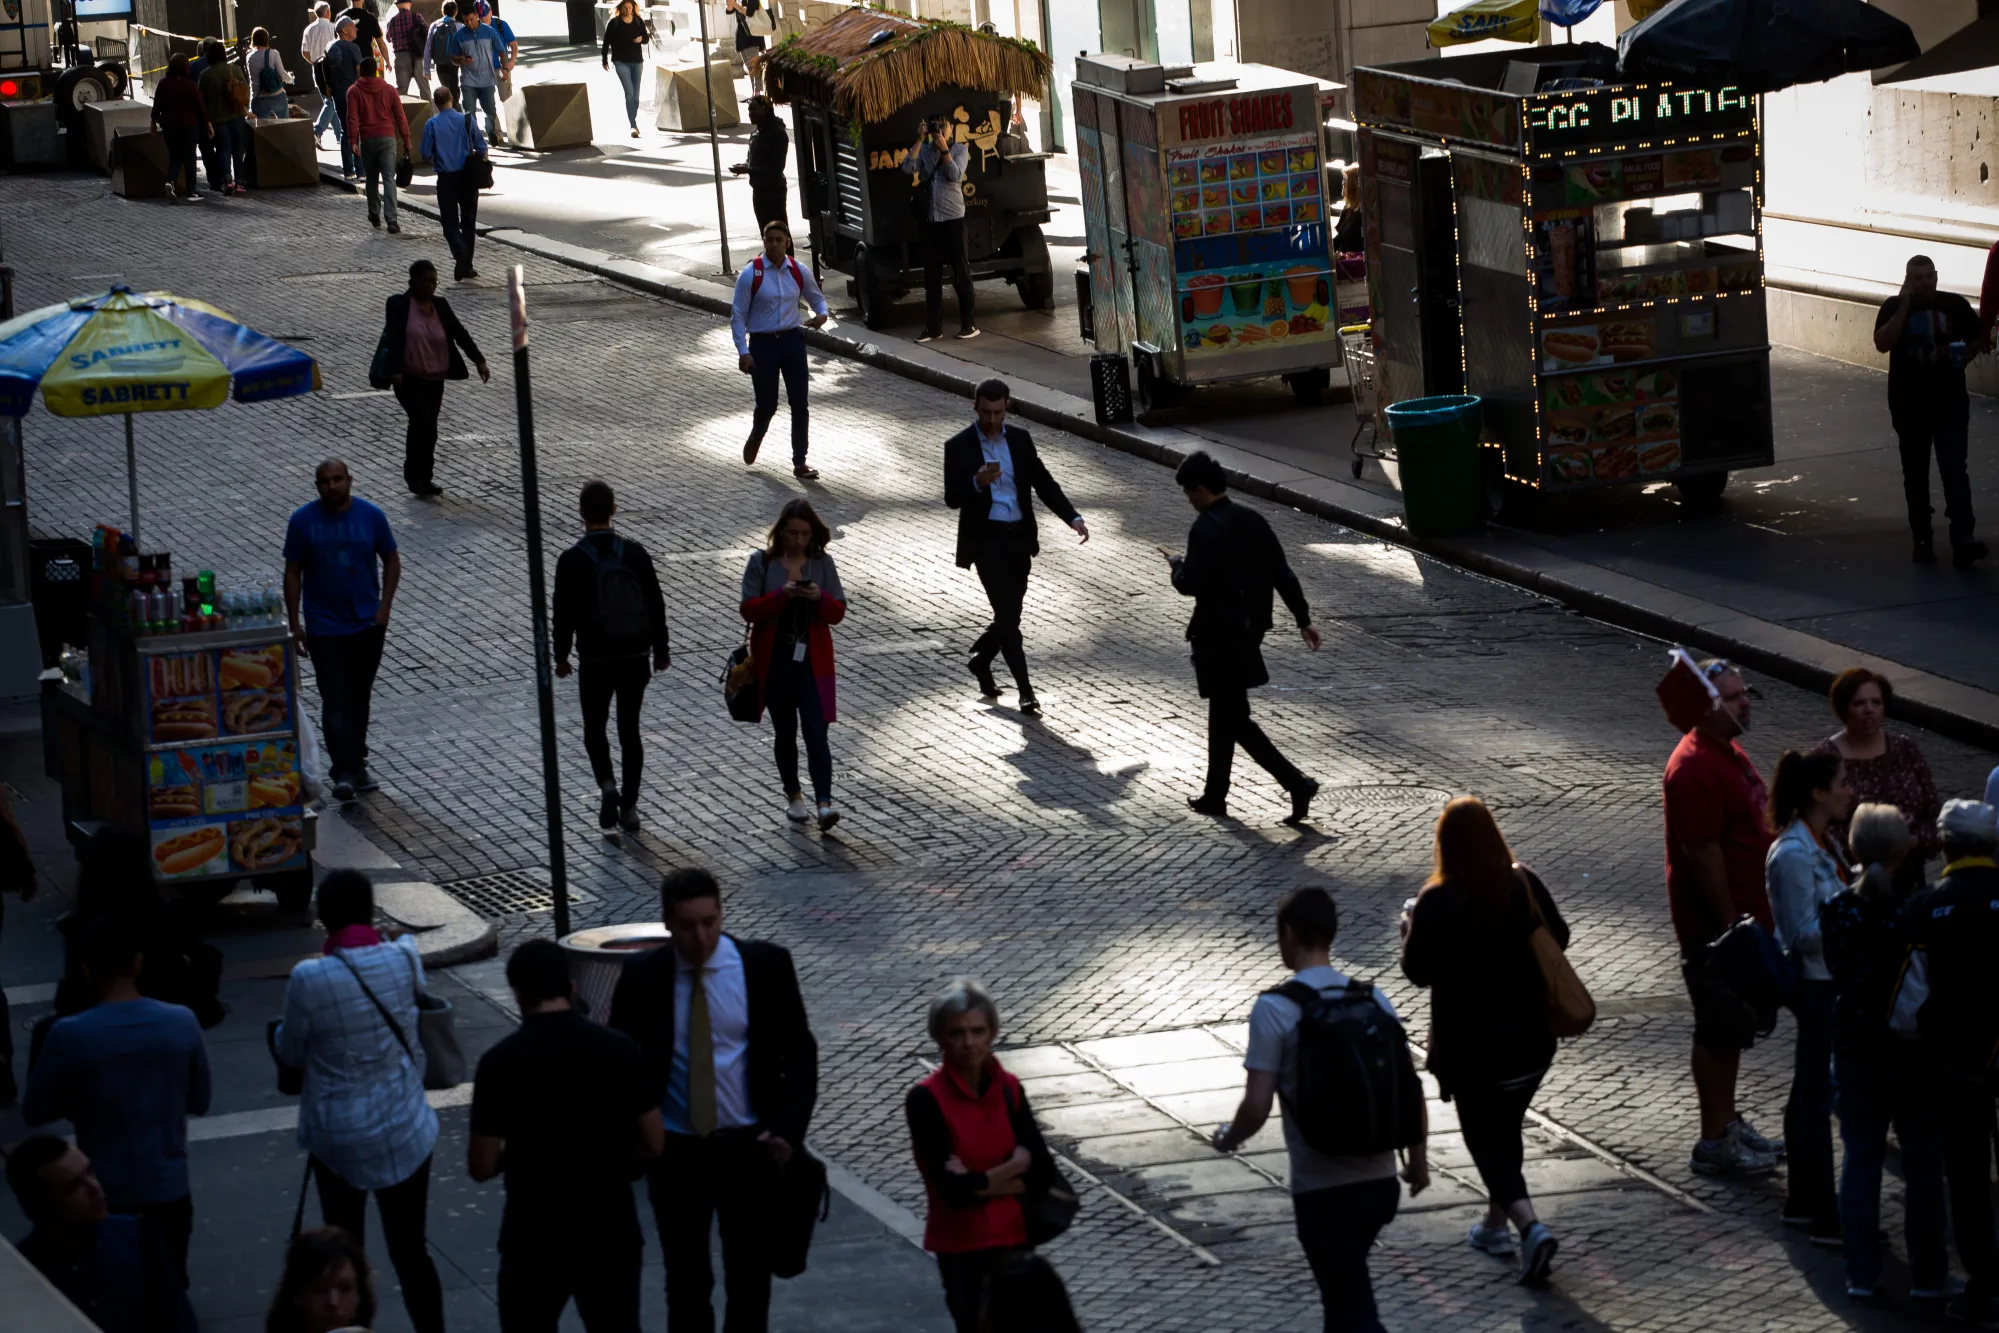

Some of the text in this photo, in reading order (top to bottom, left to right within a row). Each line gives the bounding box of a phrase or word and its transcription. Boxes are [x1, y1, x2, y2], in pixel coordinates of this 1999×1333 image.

[1179, 92, 1294, 142] FRUIT SHAKES
[1168, 144, 1246, 162] Fruit Shakes
[1623, 160, 1661, 174] HALAL FOOD
[1625, 172, 1660, 183] BREAKFAST
[1632, 182, 1654, 193] LUNCH
[82, 382, 191, 406] SABRETT
